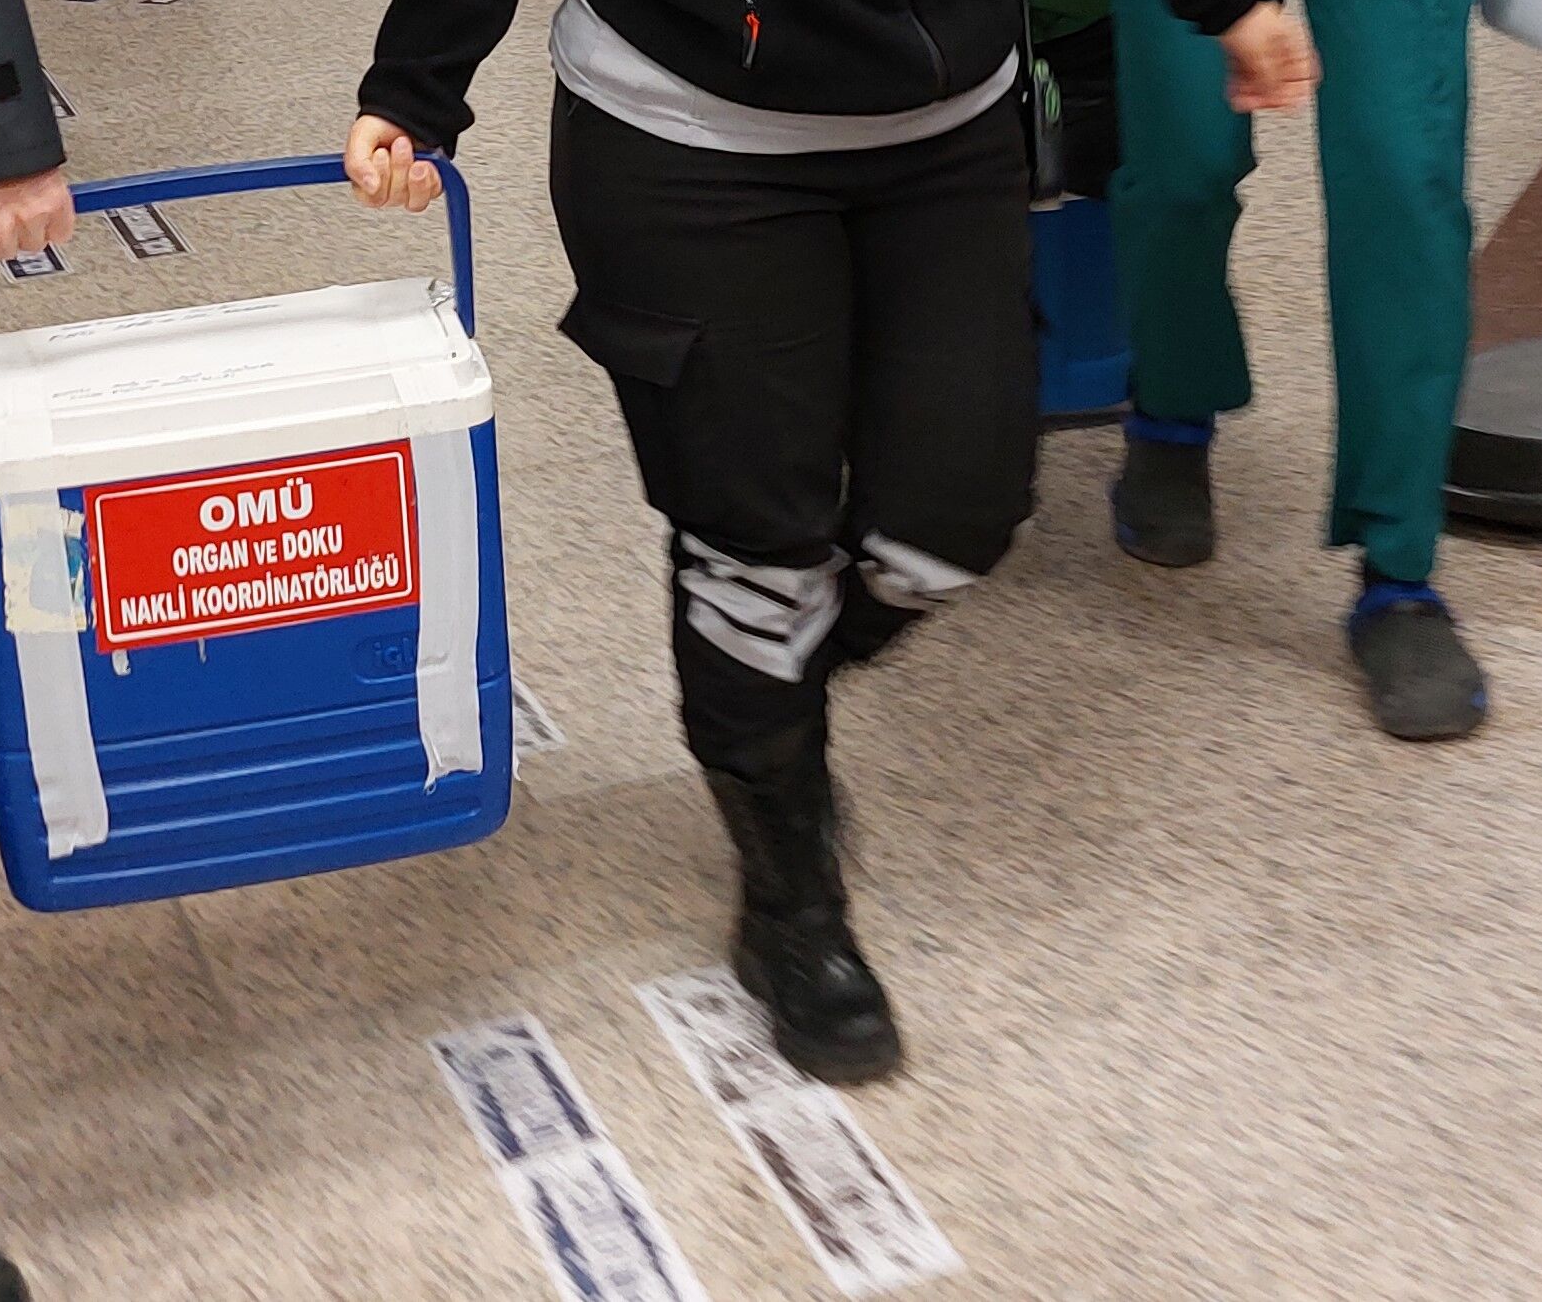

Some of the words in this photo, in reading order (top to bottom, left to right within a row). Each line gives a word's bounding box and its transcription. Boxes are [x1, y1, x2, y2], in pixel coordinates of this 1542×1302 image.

[198, 476, 314, 532] OMÜ
[172, 538, 249, 577] ORGAN
[282, 524, 343, 561] DOKU
[120, 584, 187, 627] NAKLİ
[192, 552, 400, 617] KOORDİNATÖRLÜĞÜ
